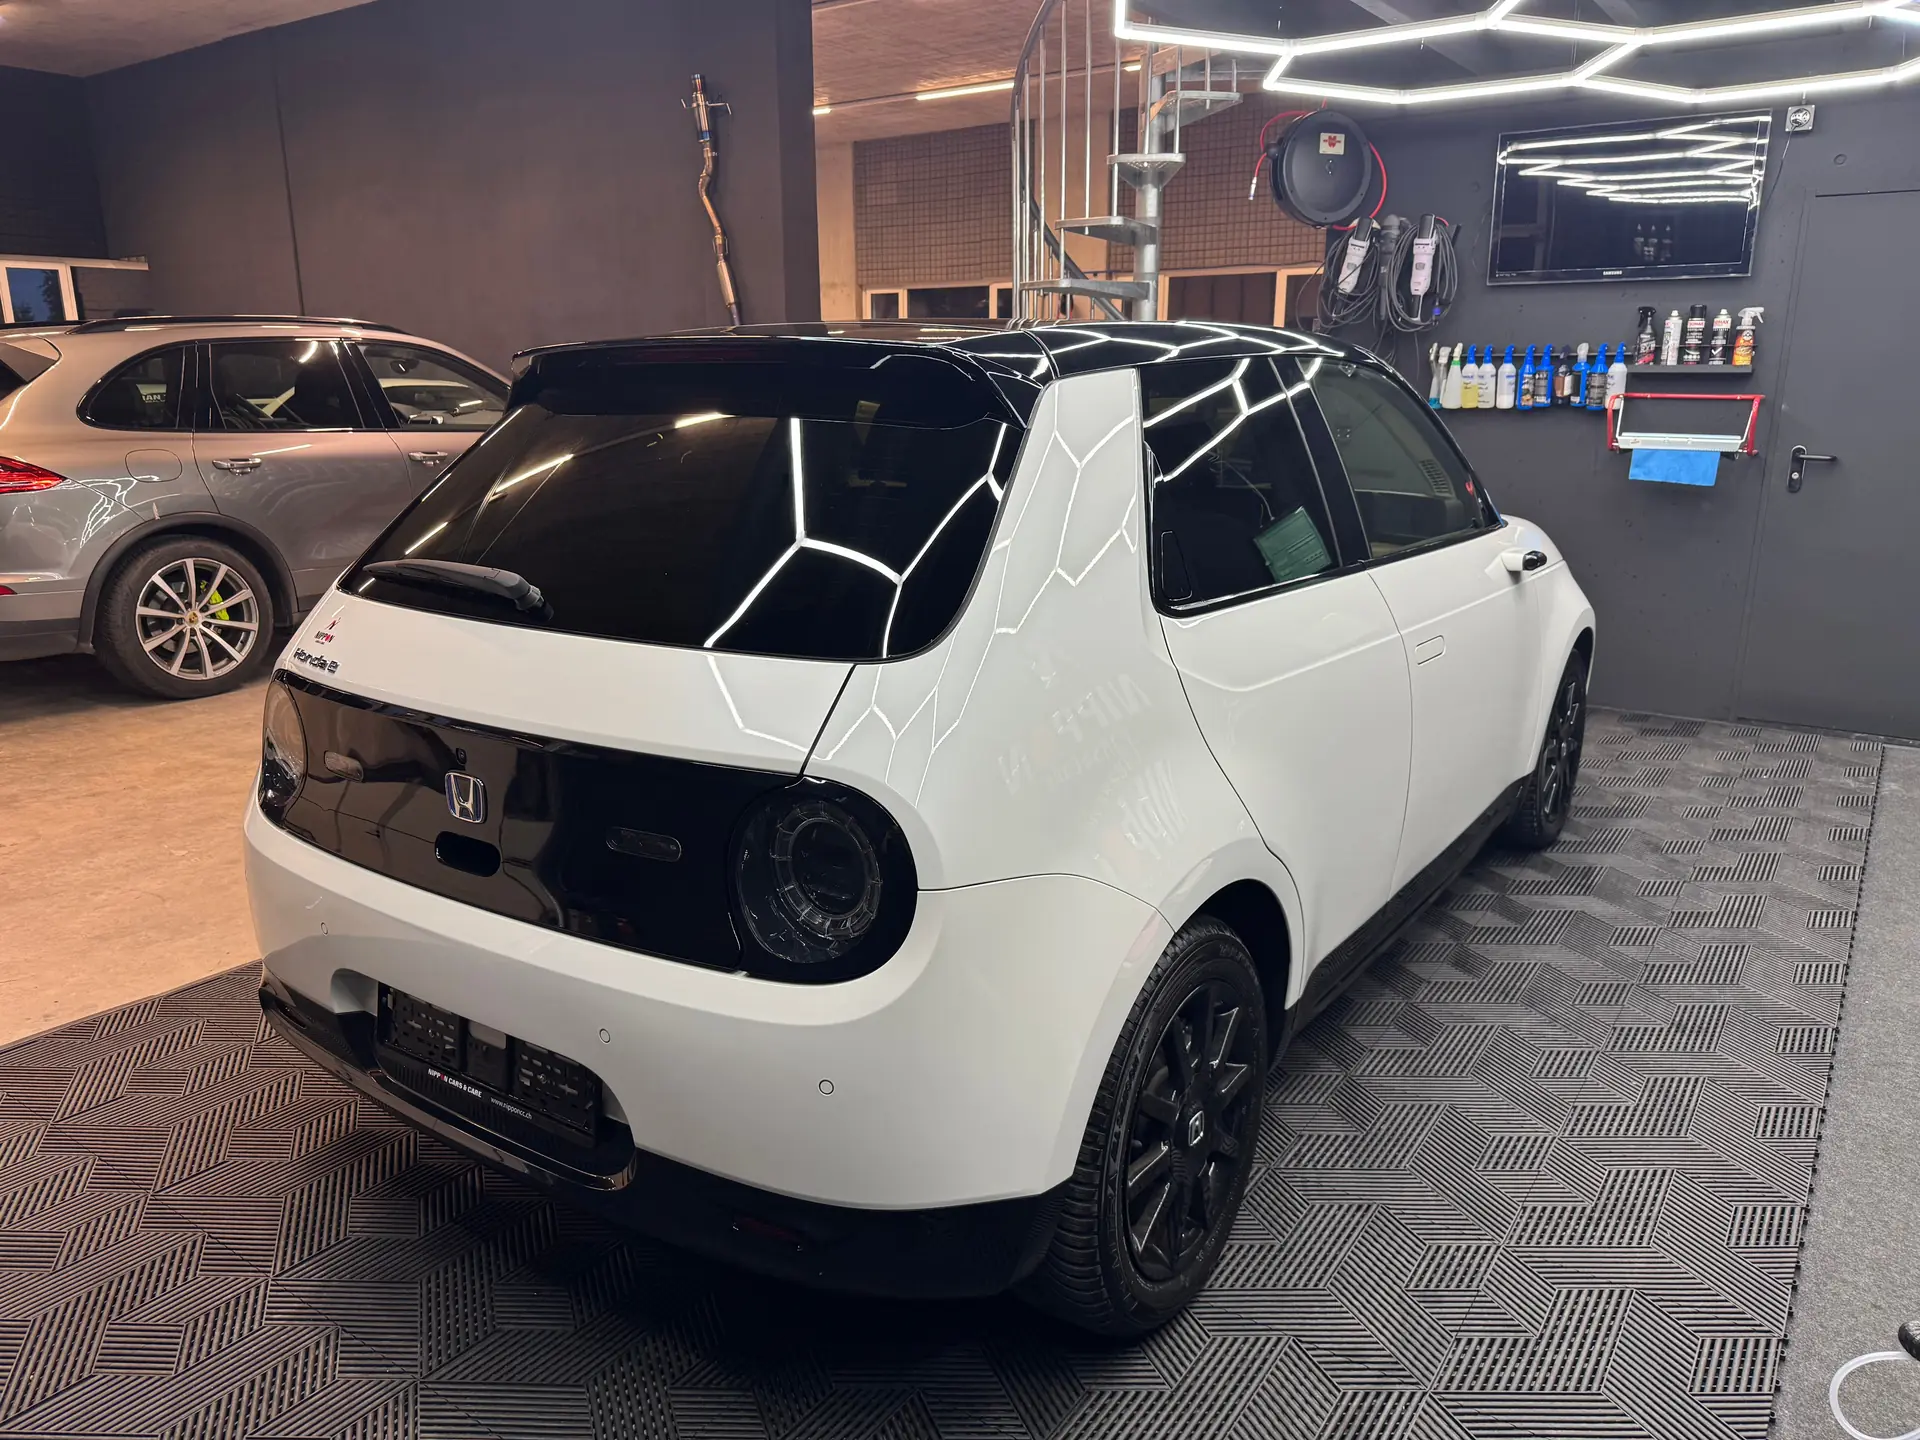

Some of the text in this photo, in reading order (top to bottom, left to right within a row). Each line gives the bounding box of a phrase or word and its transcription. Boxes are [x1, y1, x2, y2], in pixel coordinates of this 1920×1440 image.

[294, 648, 328, 671] Honda
[427, 1067, 448, 1082] NIPPON
[448, 1077, 462, 1089] CARS
[467, 1086, 482, 1098] CARE
[490, 1096, 533, 1120] www.nipponcc.ch
